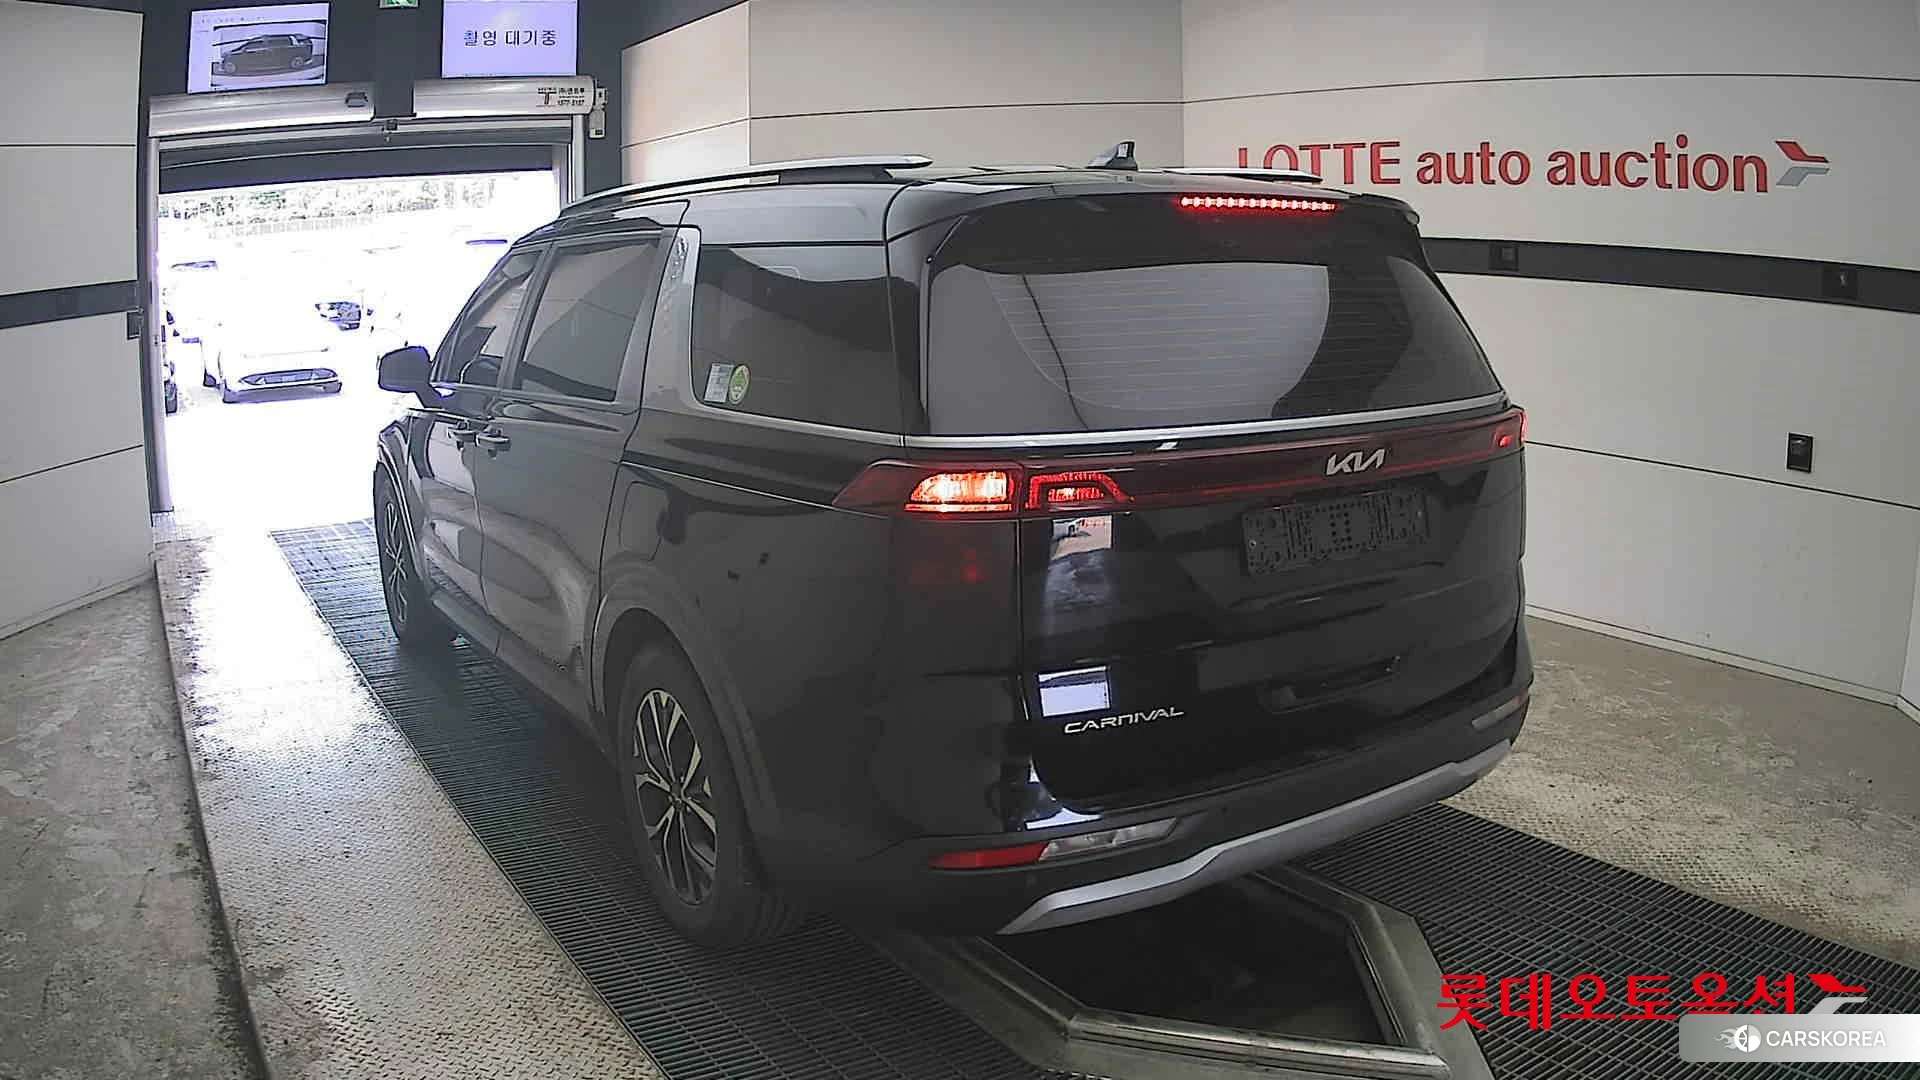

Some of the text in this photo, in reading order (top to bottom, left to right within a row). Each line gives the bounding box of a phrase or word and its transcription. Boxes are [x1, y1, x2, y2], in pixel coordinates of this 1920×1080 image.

[504, 29, 556, 47] 대기중
[1416, 141, 1531, 185] auto
[1546, 134, 1769, 193] auction
[1326, 449, 1386, 476] KIA
[1064, 706, 1185, 734] CARNIVAL
